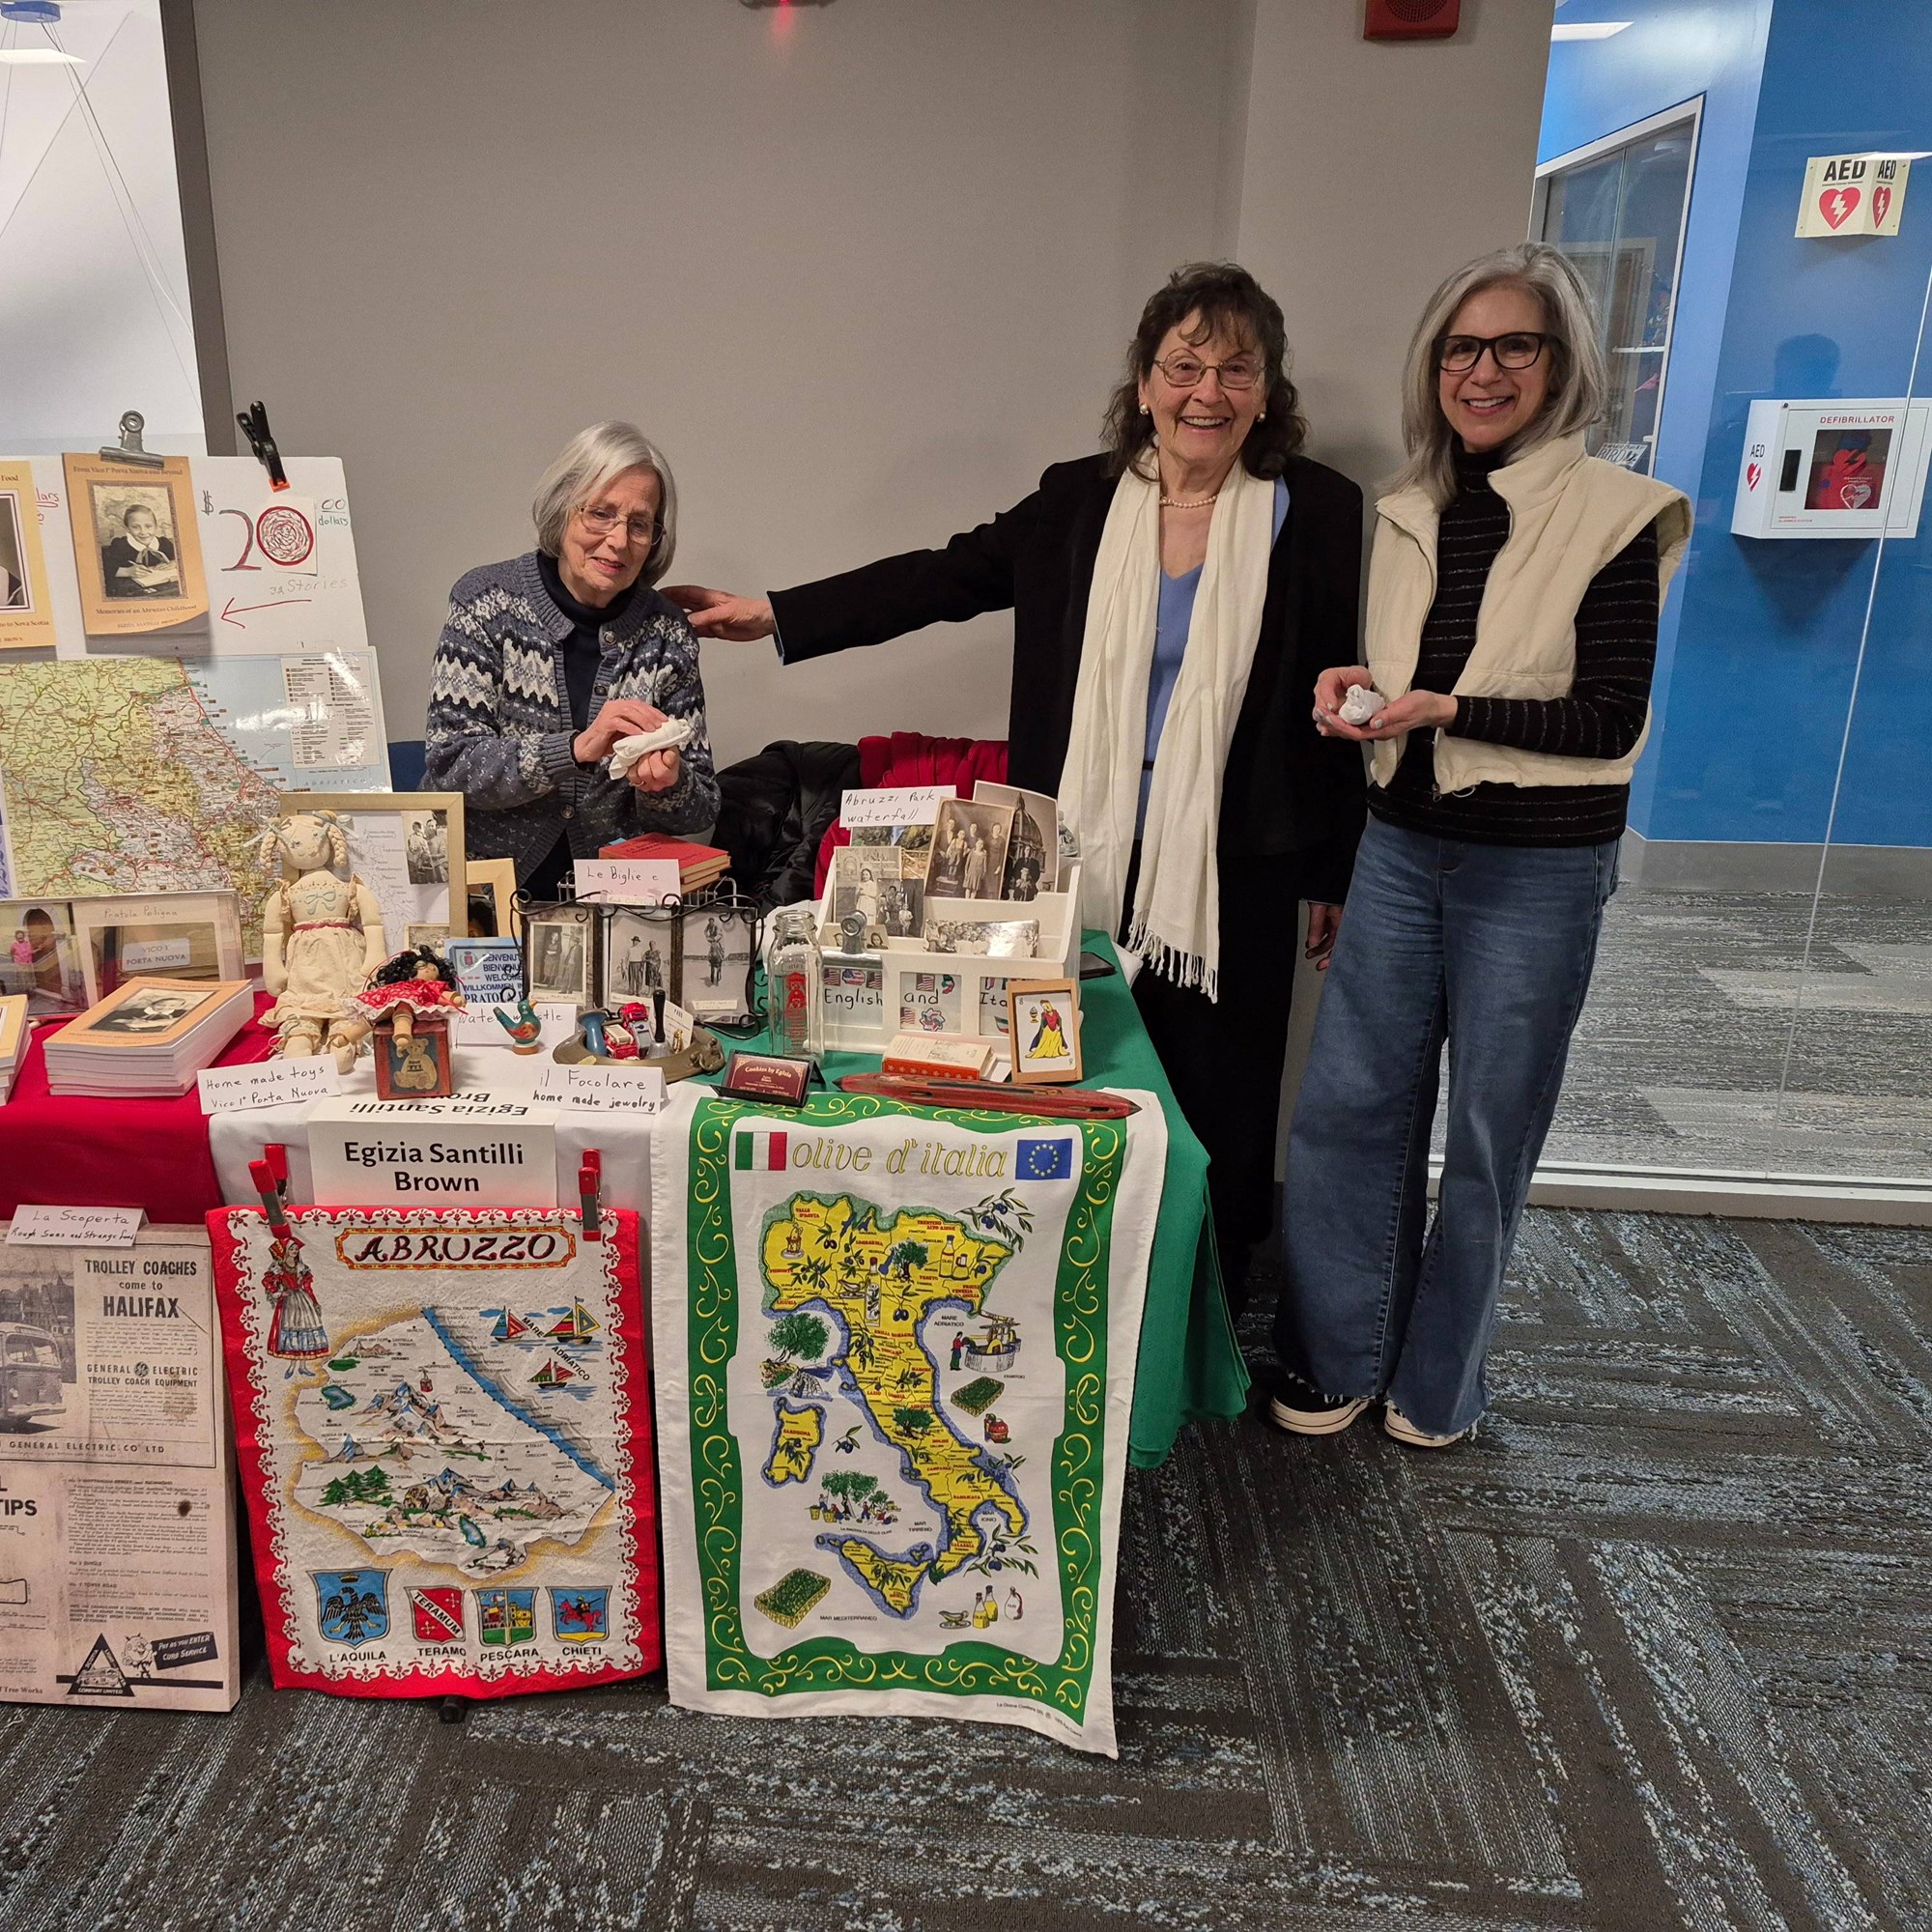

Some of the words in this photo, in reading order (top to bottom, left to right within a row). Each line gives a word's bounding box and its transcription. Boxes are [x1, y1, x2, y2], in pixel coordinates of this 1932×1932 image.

[1824, 159, 1866, 182] AED
[1877, 159, 1897, 181] AED
[1820, 415, 1895, 424] DEFIBRILLATOR
[1749, 444, 1766, 458] AED
[318, 515, 349, 526] dollars
[287, 579, 349, 593] Stories
[845, 793, 899, 806] Abruzzi
[909, 788, 935, 803] Park
[847, 808, 919, 823] waterfall
[587, 866, 604, 879] Le
[611, 866, 641, 885] Biglie
[127, 956, 153, 966] PORTA
[156, 953, 186, 962] NUOVA
[483, 952, 522, 963] BENVENUT
[824, 988, 883, 1010] English
[904, 988, 939, 1005] and
[459, 1009, 495, 1024] Wate
[206, 1078, 242, 1090] Home
[250, 1070, 285, 1086] made
[290, 1065, 325, 1081] toys
[568, 1069, 646, 1091] Focolare
[211, 1097, 235, 1109] Vico
[291, 1087, 328, 1099] Nuova
[532, 1090, 563, 1102] home
[572, 1093, 601, 1107] made
[344, 1141, 424, 1168] Egizia
[429, 1143, 524, 1165] Santilli
[792, 1137, 873, 1173] olive
[394, 1171, 480, 1193] Brown
[33, 1210, 50, 1222] La
[60, 1209, 130, 1229] Scoperta
[354, 1234, 557, 1263] ABRUZZO
[85, 1259, 136, 1275] TROLLEY
[143, 1261, 197, 1276] COACHES
[119, 1281, 146, 1290] come
[152, 1281, 163, 1291] to
[102, 1295, 180, 1319] HALIFAX
[522, 1317, 545, 1339] MARE
[87, 1363, 130, 1374] GENERAL
[153, 1366, 198, 1377] ELECTRIC
[552, 1346, 590, 1381] ADRIATICO
[88, 1376, 121, 1386] TROLLEY
[125, 1378, 151, 1386] COACH
[155, 1378, 198, 1388] EQUIPMENT
[9, 1440, 59, 1450] GENERAL
[67, 1442, 116, 1452] ELECTRIC
[123, 1444, 138, 1453] CO
[146, 1445, 165, 1454] LTD
[412, 1591, 462, 1635] TERAMUM
[329, 1650, 386, 1663] L'AQUILA
[416, 1646, 468, 1659] TERAMO
[480, 1647, 540, 1663] PESCARA
[561, 1646, 602, 1658] CHIETI
